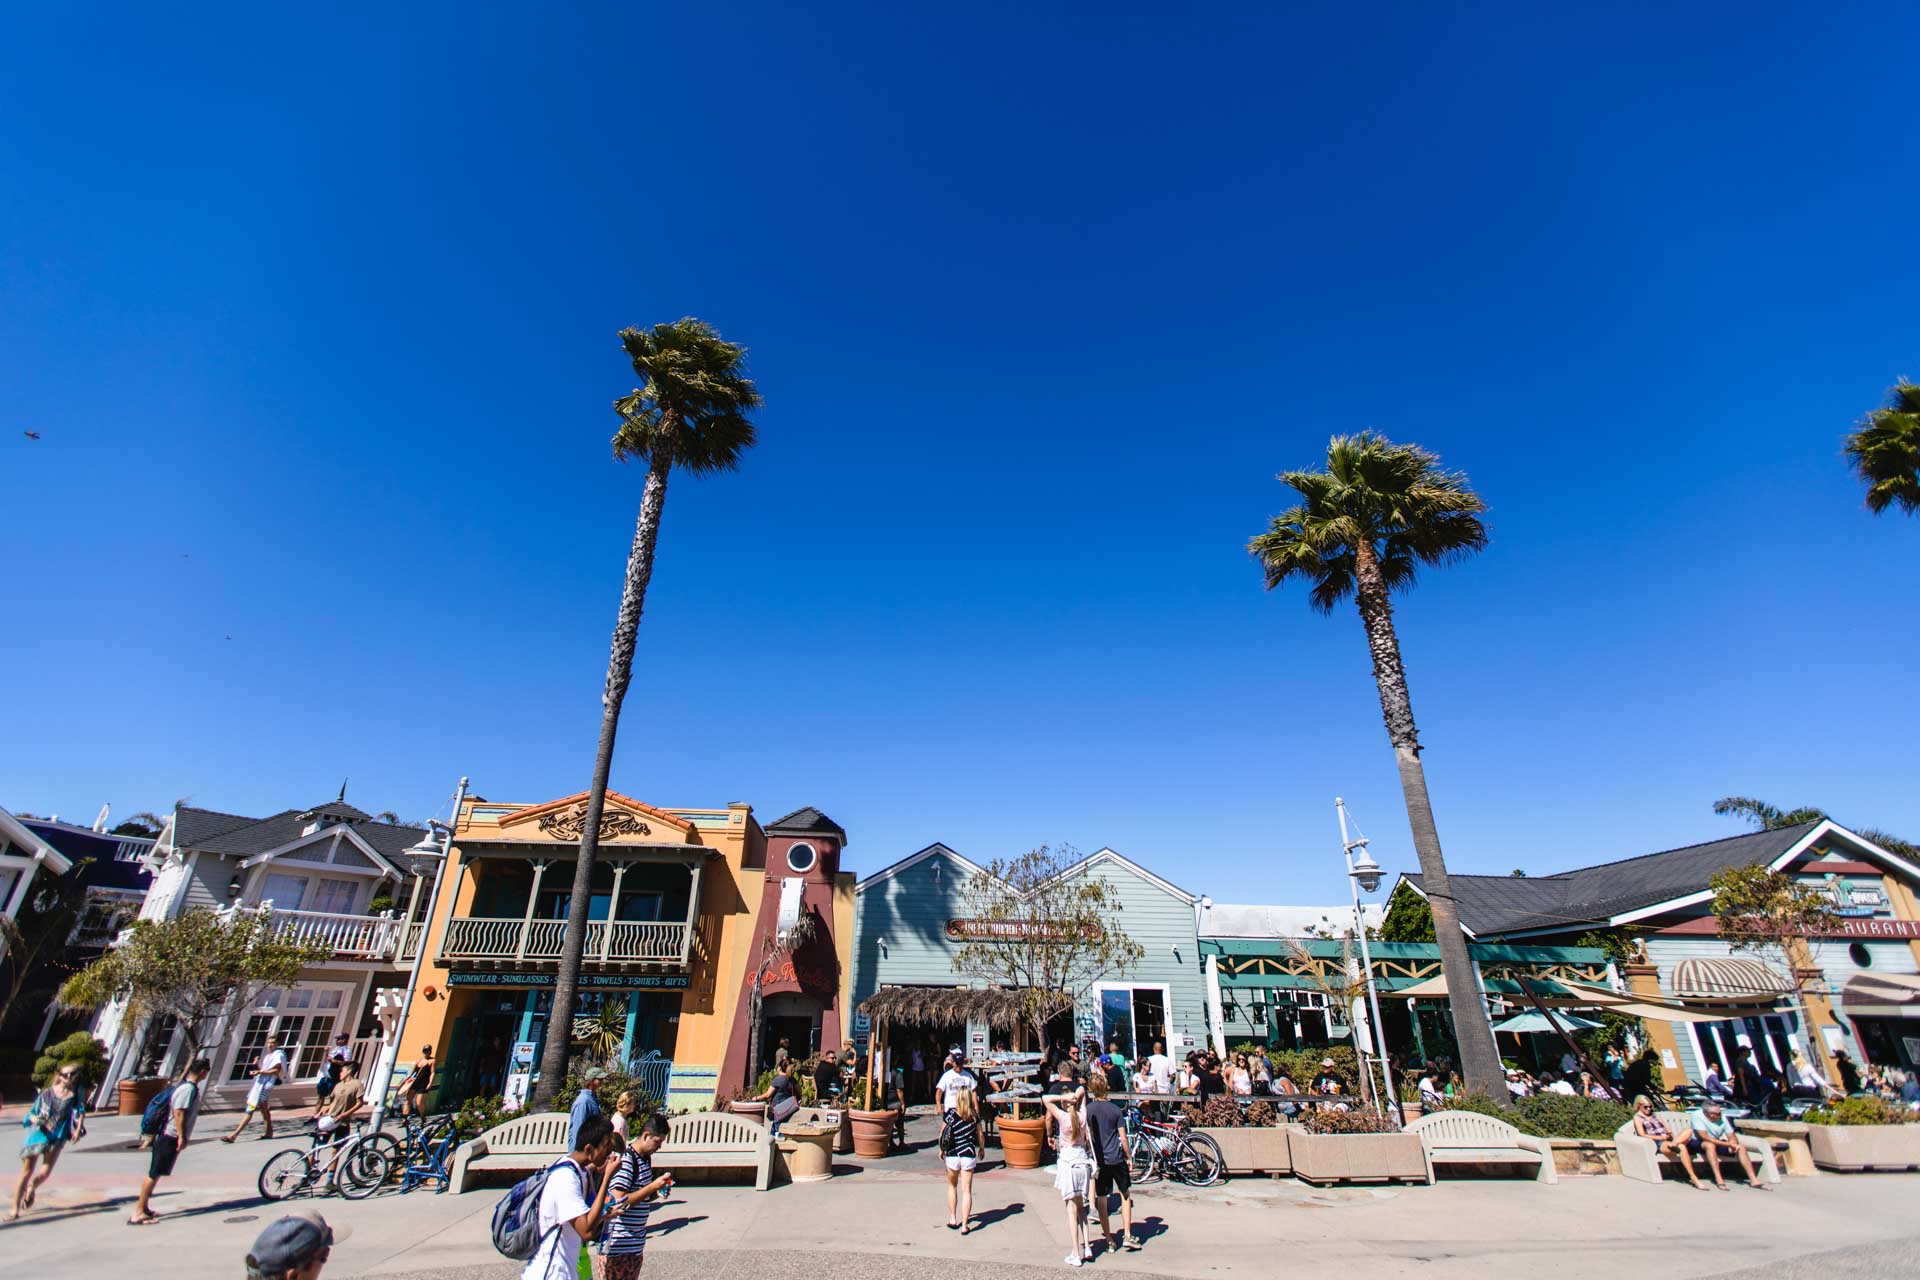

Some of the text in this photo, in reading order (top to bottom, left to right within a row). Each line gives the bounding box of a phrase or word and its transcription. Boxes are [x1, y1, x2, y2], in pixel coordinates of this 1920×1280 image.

[1796, 921, 1919, 936] AURANT
[451, 974, 497, 983] SWIMWEAR
[502, 975, 549, 983] SUNGLASSES
[593, 976, 622, 985] TOWELS
[628, 976, 660, 985] T-SHIRTS
[665, 977, 687, 986] GIFTS
